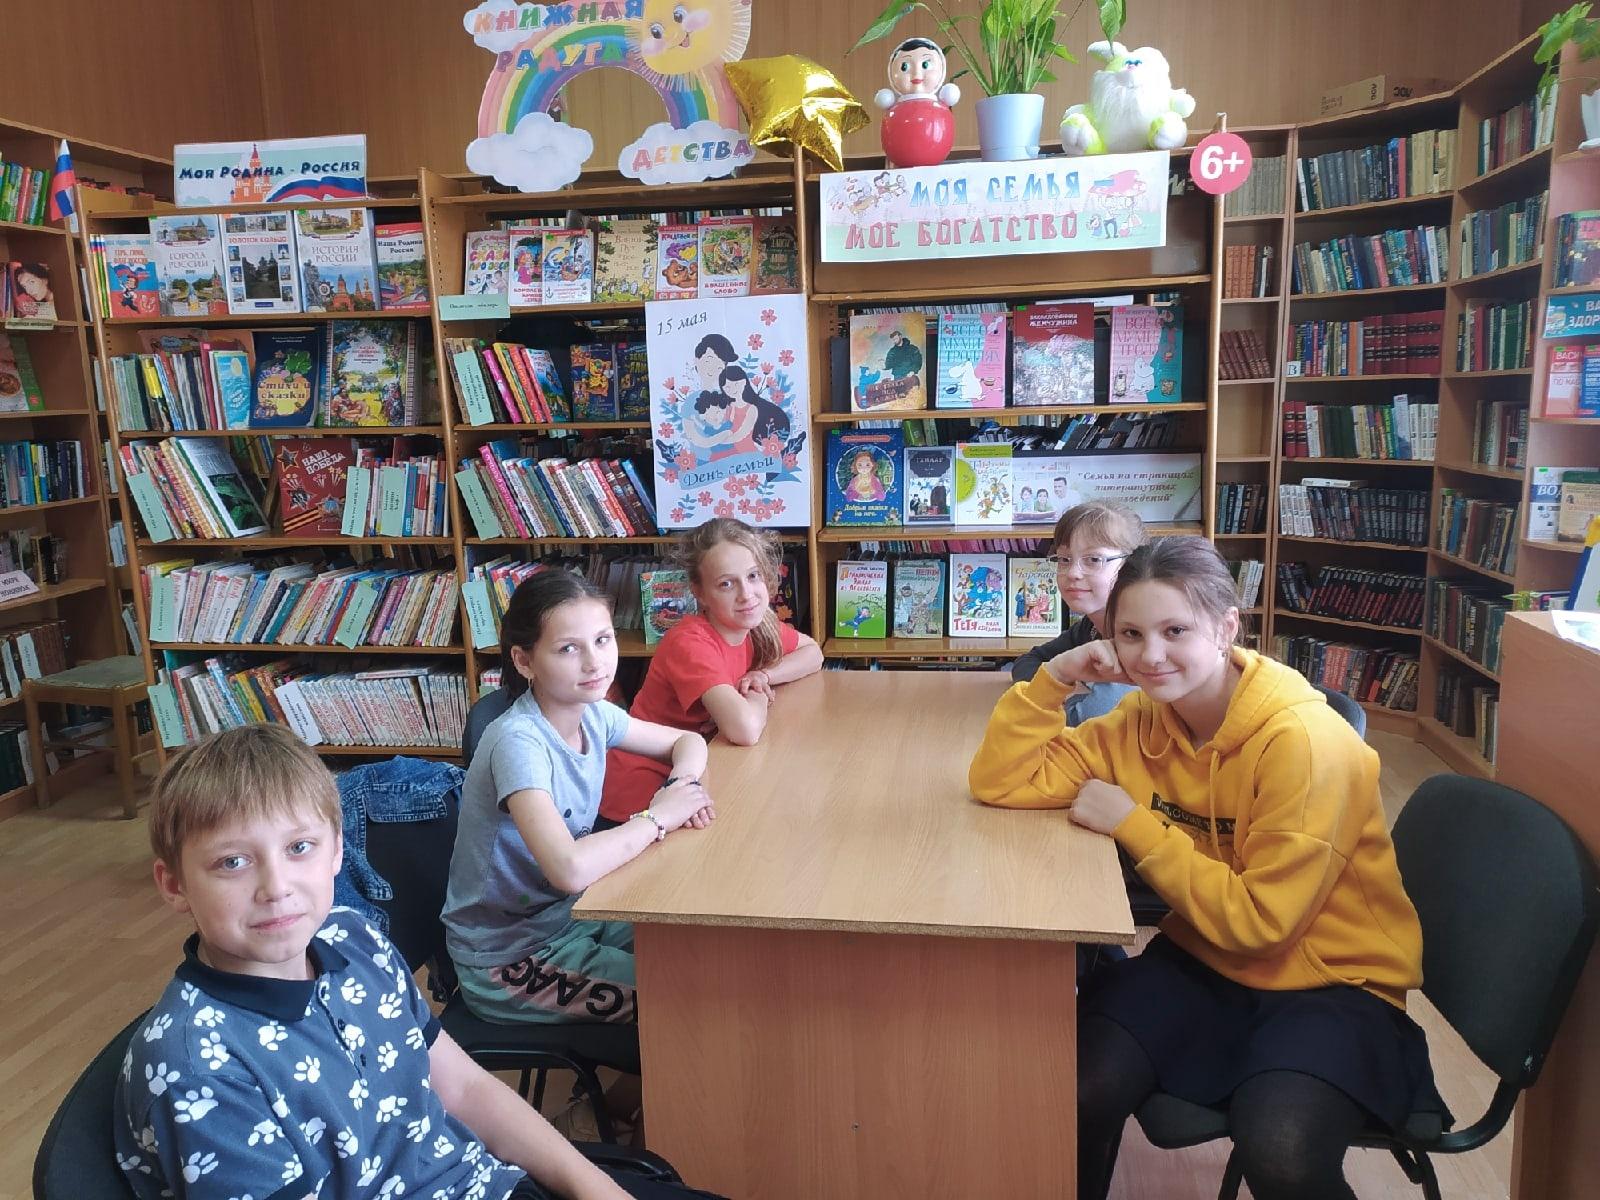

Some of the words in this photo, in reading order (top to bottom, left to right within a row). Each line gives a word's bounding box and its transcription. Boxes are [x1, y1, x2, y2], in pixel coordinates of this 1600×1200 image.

[474, 0, 644, 33] КНИЖНАЯ
[497, 41, 623, 73] РАДУГА
[632, 139, 752, 173] ДЕТСТВА
[1199, 145, 1245, 181] 6+
[909, 178, 968, 208] МОЯ
[987, 171, 1081, 203] СЕМЬЯ
[844, 221, 901, 250] МОЕ
[917, 211, 1079, 247] БОГАТСТВО
[312, 244, 359, 255] ИСТОРИЯ
[315, 253, 358, 263] РОССИИ
[657, 319, 673, 336] 15
[677, 311, 708, 331] мая
[302, 449, 331, 468] НАША
[306, 452, 346, 475] ПОБЕДА
[683, 468, 723, 486] День
[729, 456, 775, 474] семьи
